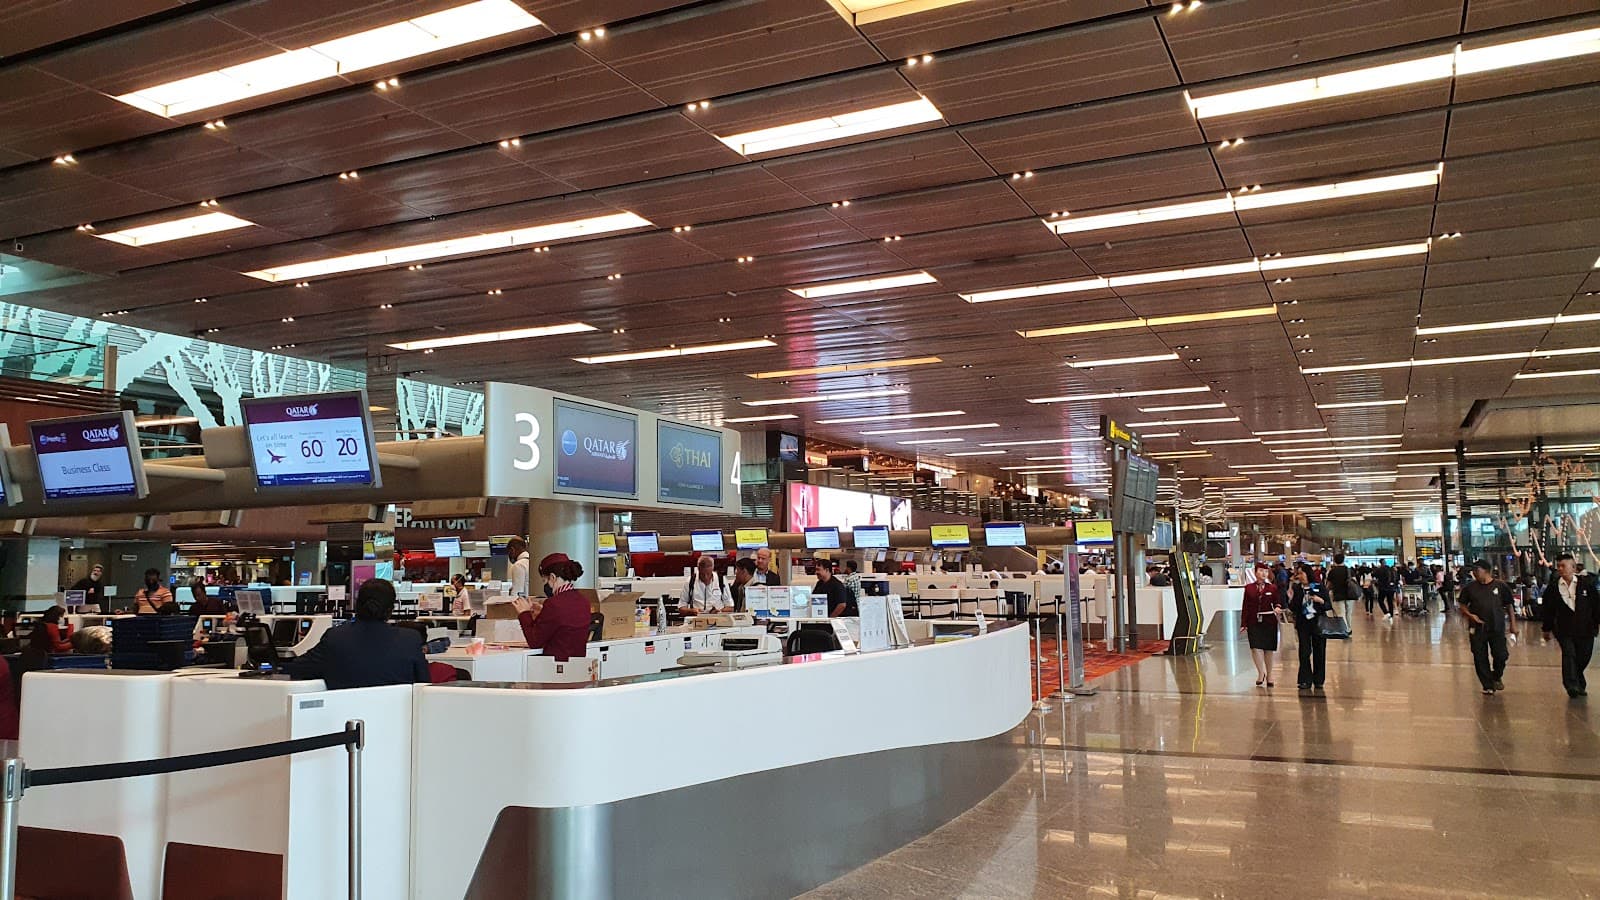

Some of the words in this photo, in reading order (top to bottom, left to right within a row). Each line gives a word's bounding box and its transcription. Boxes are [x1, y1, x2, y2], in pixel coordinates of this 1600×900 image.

[286, 406, 308, 416] QATAR
[82, 428, 108, 440] QATAR
[513, 412, 540, 471] 3
[301, 439, 323, 458] 60
[336, 437, 358, 456] 20
[583, 437, 616, 454] QATAR
[684, 448, 711, 468] THAI
[61, 466, 91, 475] Business
[92, 463, 111, 473] Class
[730, 451, 741, 494] 4
[1231, 527, 1238, 537] 7
